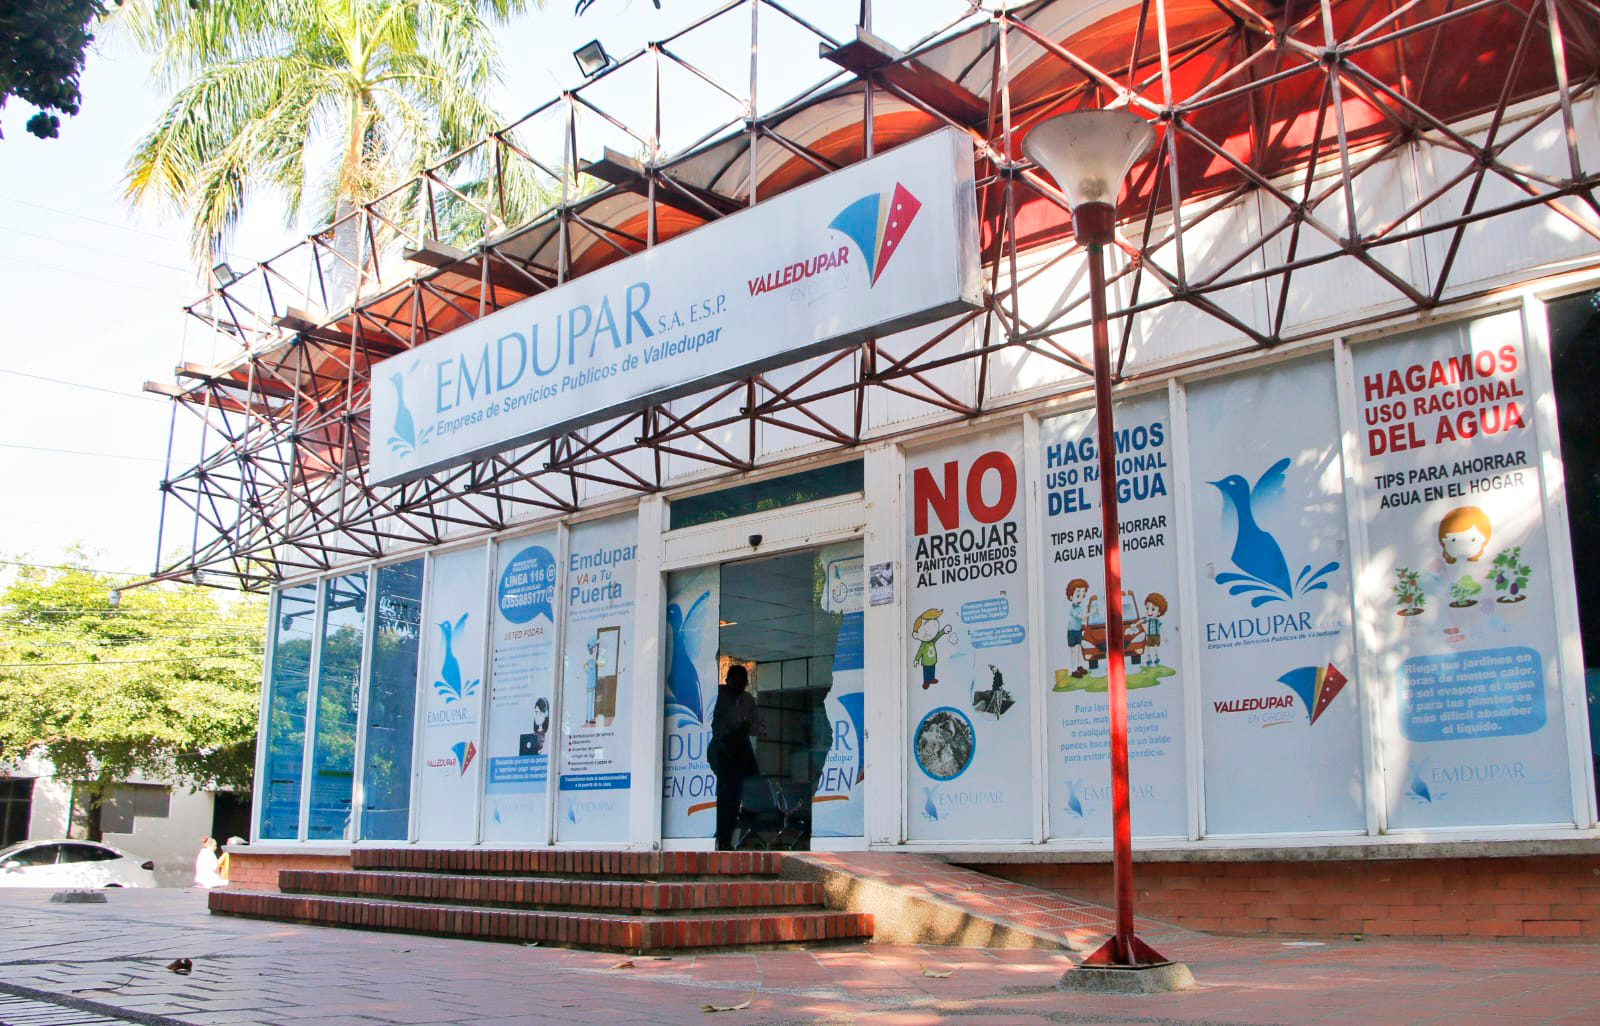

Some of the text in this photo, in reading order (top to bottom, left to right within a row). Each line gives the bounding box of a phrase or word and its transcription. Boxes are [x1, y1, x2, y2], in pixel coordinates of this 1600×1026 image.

[747, 246, 849, 297] VALLEDUPAR
[436, 281, 727, 414] EMDUPAR S.A. E.S.P.
[436, 327, 722, 436] Empresa de Servicios Publicos de Valledupar
[1363, 345, 1519, 402] HAGAMOS
[1365, 378, 1524, 426] USO RACIONAL
[1368, 402, 1526, 457] DEL AGUA
[1047, 422, 1165, 469] HAGMOS
[1046, 451, 1167, 490] USO RIONAL
[1375, 451, 1528, 490] TIPS PARA AHORRAR
[914, 451, 1017, 536] NO
[1048, 472, 1168, 517] DEL GUA
[1380, 472, 1525, 509] AGUA EN EL HOGAR
[915, 521, 1019, 561] ARROJAR
[1051, 530, 1074, 546] TIPS
[1117, 515, 1167, 535] HORRAR
[569, 544, 638, 572] Emdupar
[963, 545, 1017, 566] HUMEDOS
[1054, 533, 1165, 563] AGUA EN HOGAR
[531, 569, 545, 583] 116
[577, 569, 612, 585] VA a Tu
[916, 572, 938, 589] AL
[942, 558, 1018, 585] INODORO
[570, 581, 622, 607] Puerta
[1206, 611, 1312, 642] EMDUPAR
[1439, 673, 1453, 682] de
[1456, 671, 1497, 682] menos
[1463, 656, 1512, 670] jardines
[1516, 654, 1532, 662] en
[1213, 695, 1294, 714] VALLEDUPAR
[1416, 687, 1434, 698] sol
[1438, 684, 1486, 697] evapora
[1504, 680, 1536, 692] agua
[1416, 702, 1443, 713] para
[1468, 695, 1514, 709] plantas
[1478, 706, 1532, 719] absorber
[1442, 724, 1454, 735] el
[663, 775, 685, 798] EN
[1432, 761, 1527, 783] EMDUPAR
